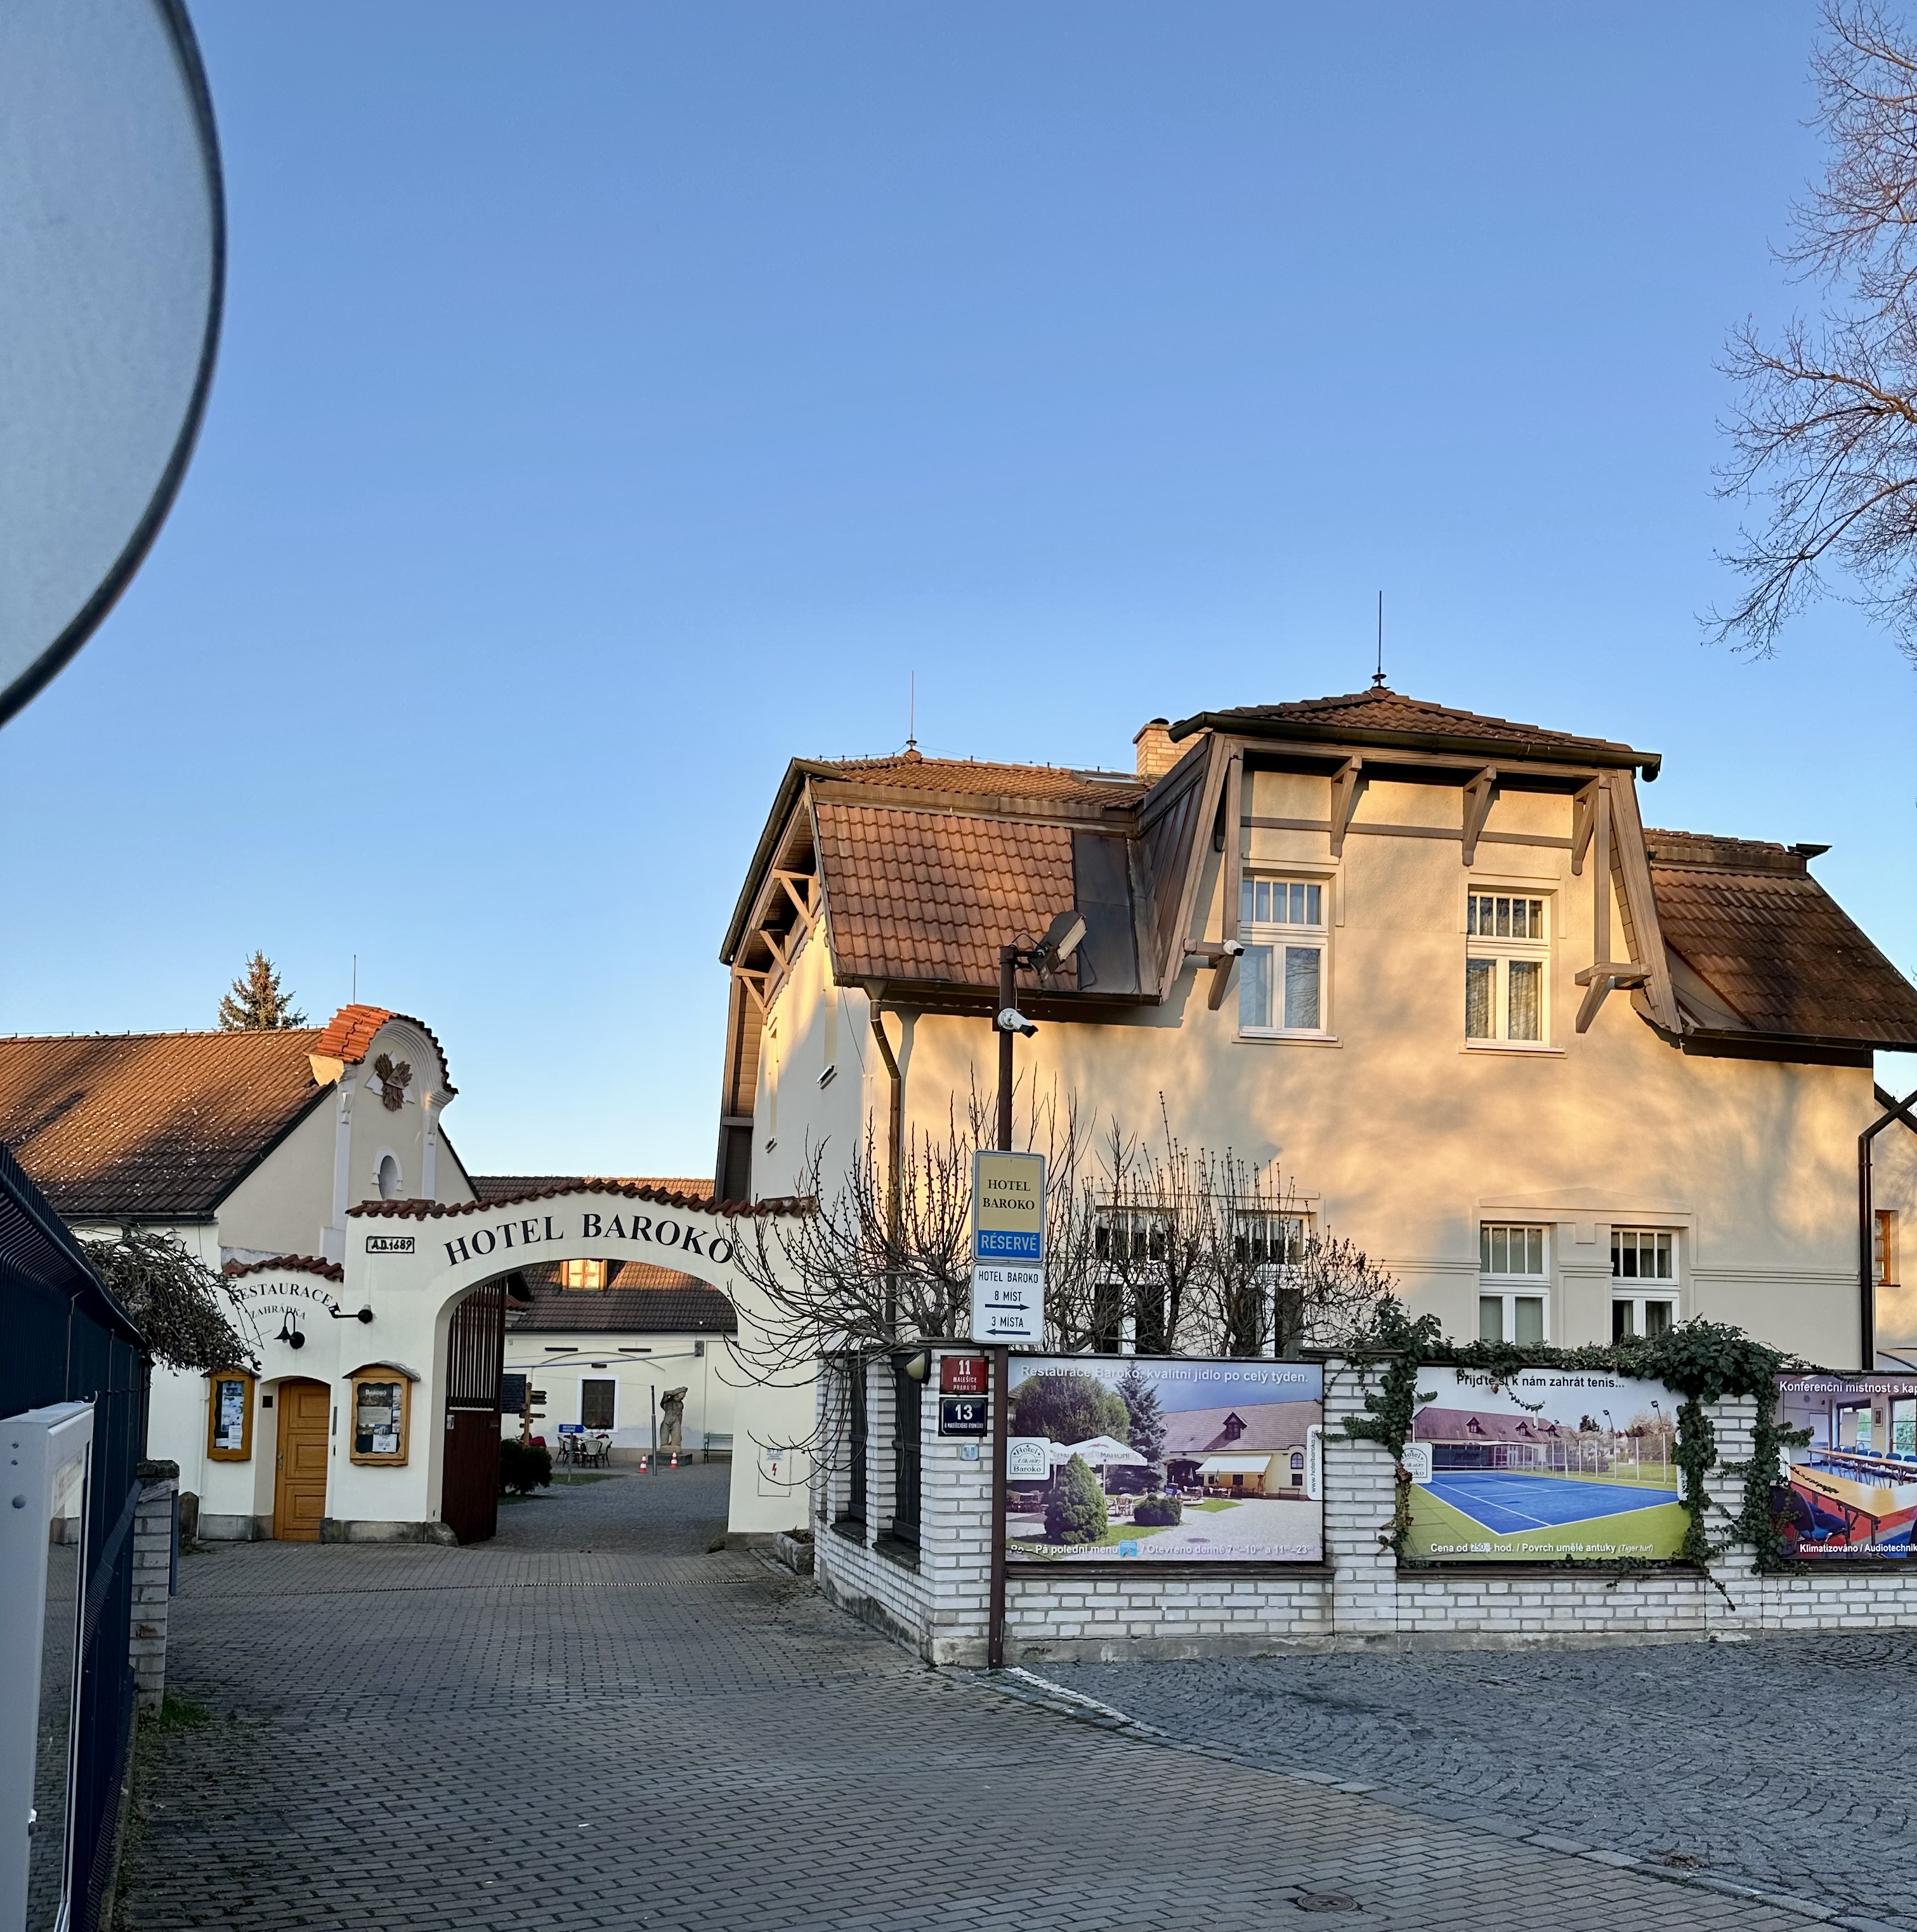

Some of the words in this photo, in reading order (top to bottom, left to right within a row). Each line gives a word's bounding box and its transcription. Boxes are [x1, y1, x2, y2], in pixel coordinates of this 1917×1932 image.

[988, 1179, 1031, 1192] HOTEL
[983, 1198, 1035, 1210] BAROKO
[442, 1215, 565, 1267] HOTEL
[581, 1213, 735, 1264] BAROKO
[981, 1233, 1037, 1251] RÉSERVÉ
[979, 1270, 1003, 1282] HOTEL
[1007, 1272, 1038, 1284] BAROKO
[994, 1290, 999, 1300] 8
[1003, 1288, 1022, 1302] MÍST
[250, 1303, 306, 1320] ZAHRÁDKA
[991, 1316, 996, 1326] 3
[1000, 1314, 1024, 1328] MÍSTA
[958, 1360, 971, 1375] 11
[1020, 1365, 1091, 1377] Restaurace
[1095, 1366, 1143, 1380] Baroko,
[1147, 1368, 1191, 1380] kvalitní
[1193, 1369, 1221, 1383] jídlo
[1224, 1372, 1240, 1383] po
[1243, 1370, 1269, 1384] celý
[1271, 1370, 1309, 1385] týden.
[1512, 1375, 1519, 1385] k
[1522, 1375, 1546, 1386] nám
[1549, 1376, 1585, 1387] zahrát
[1779, 1380, 1843, 1392] Konferenční
[1845, 1381, 1891, 1393] místnost
[1893, 1385, 1899, 1393] s
[955, 1404, 973, 1420] 13
[1016, 1447, 1038, 1455] Hotel
[1009, 1544, 1024, 1554] Po
[1035, 1544, 1049, 1554] Pá
[1051, 1544, 1088, 1556] polední
[1090, 1546, 1118, 1554] menu
[1148, 1544, 1192, 1554] Otevřeno
[1194, 1544, 1226, 1554] denně
[1430, 1543, 1454, 1552] Cena
[1456, 1543, 1468, 1552] od
[1494, 1543, 1514, 1552] hod.
[1516, 1543, 1520, 1552] /
[1522, 1543, 1554, 1552] Povrch
[1556, 1543, 1584, 1552] umělé
[1586, 1543, 1616, 1554] antuky
[1618, 1544, 1639, 1553] (Tiger
[1800, 1543, 1859, 1553] Klimatizováno
[1859, 1543, 1863, 1553] /
